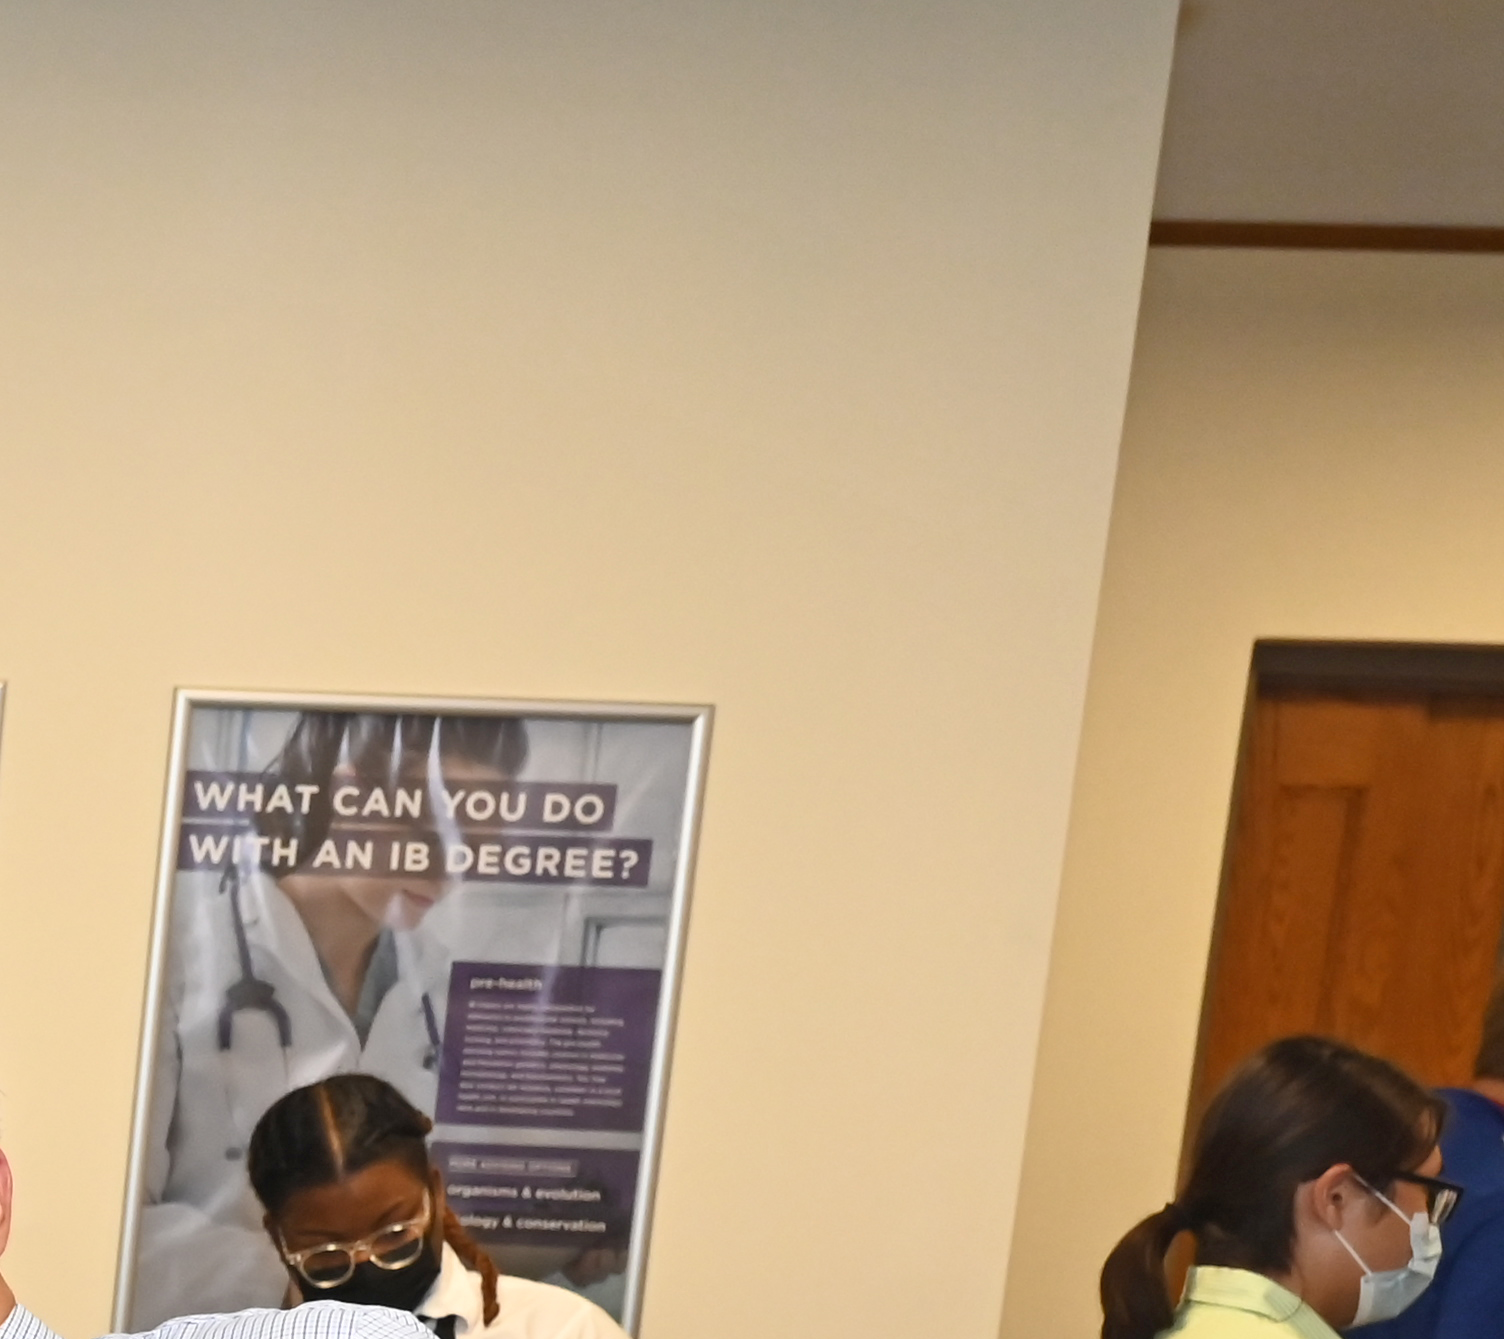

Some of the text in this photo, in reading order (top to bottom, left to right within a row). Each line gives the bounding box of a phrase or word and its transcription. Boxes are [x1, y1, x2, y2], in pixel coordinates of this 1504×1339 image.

[194, 781, 605, 826] WHAT CAN YOU DO
[189, 834, 640, 880] WITH AN IB DEGREE?
[469, 977, 543, 992] pre-health
[535, 1187, 602, 1202] evolution
